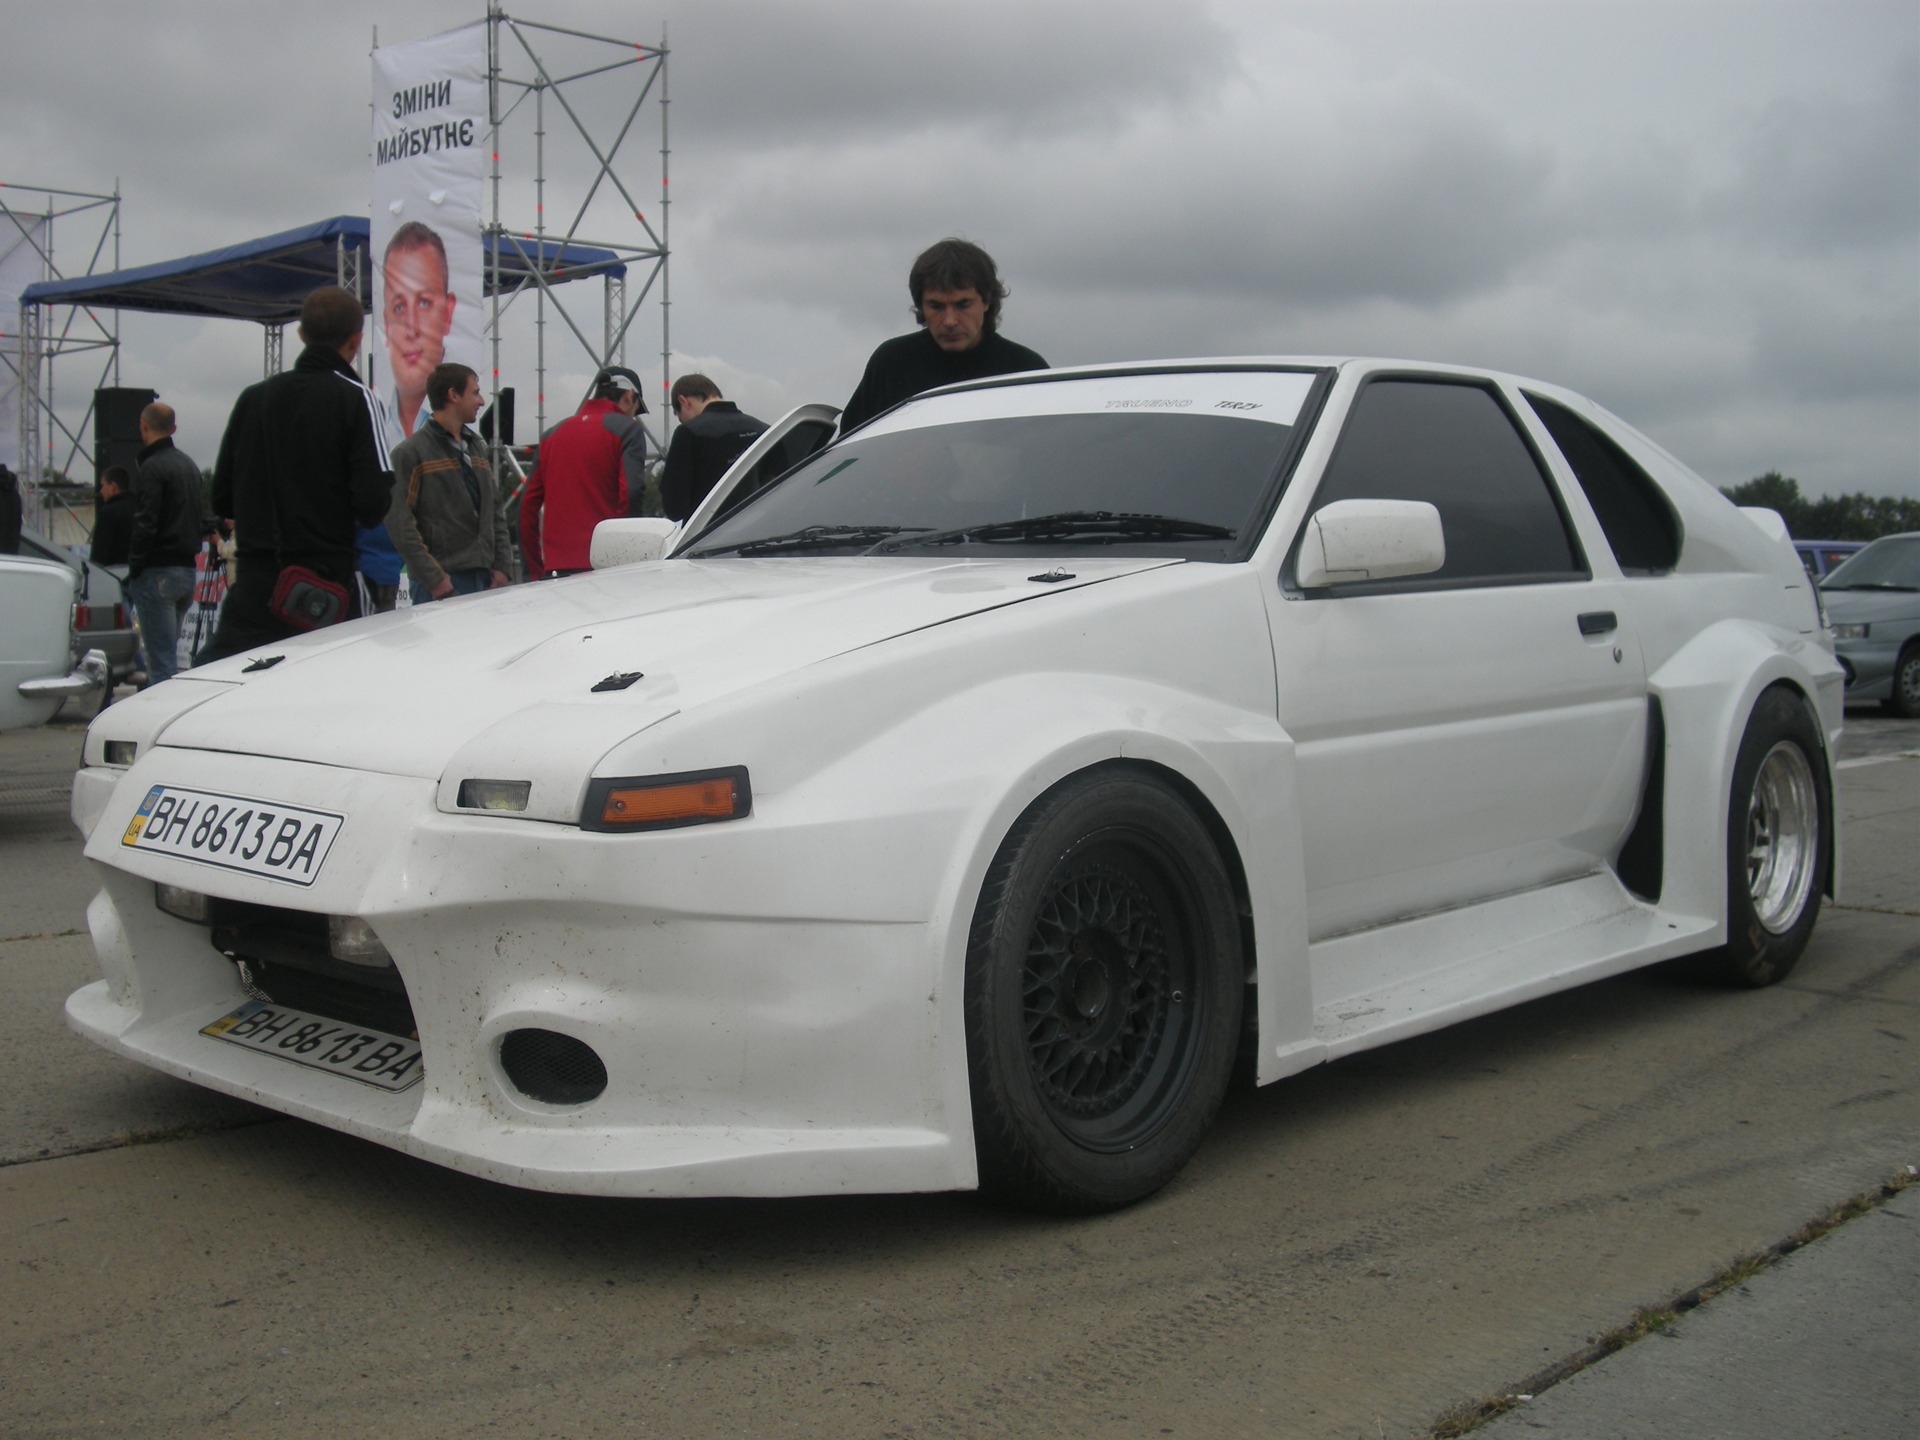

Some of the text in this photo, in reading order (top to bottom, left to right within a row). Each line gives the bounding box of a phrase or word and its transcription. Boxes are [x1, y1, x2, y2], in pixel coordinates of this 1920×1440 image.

[393, 79, 451, 119] ЗМІНИ
[377, 118, 474, 166] МАЙБУТНЄ
[1105, 399, 1193, 409] TRUENO
[127, 823, 140, 838] UA
[143, 796, 324, 873] BH 8613 BA
[278, 1022, 377, 1064] 8613
